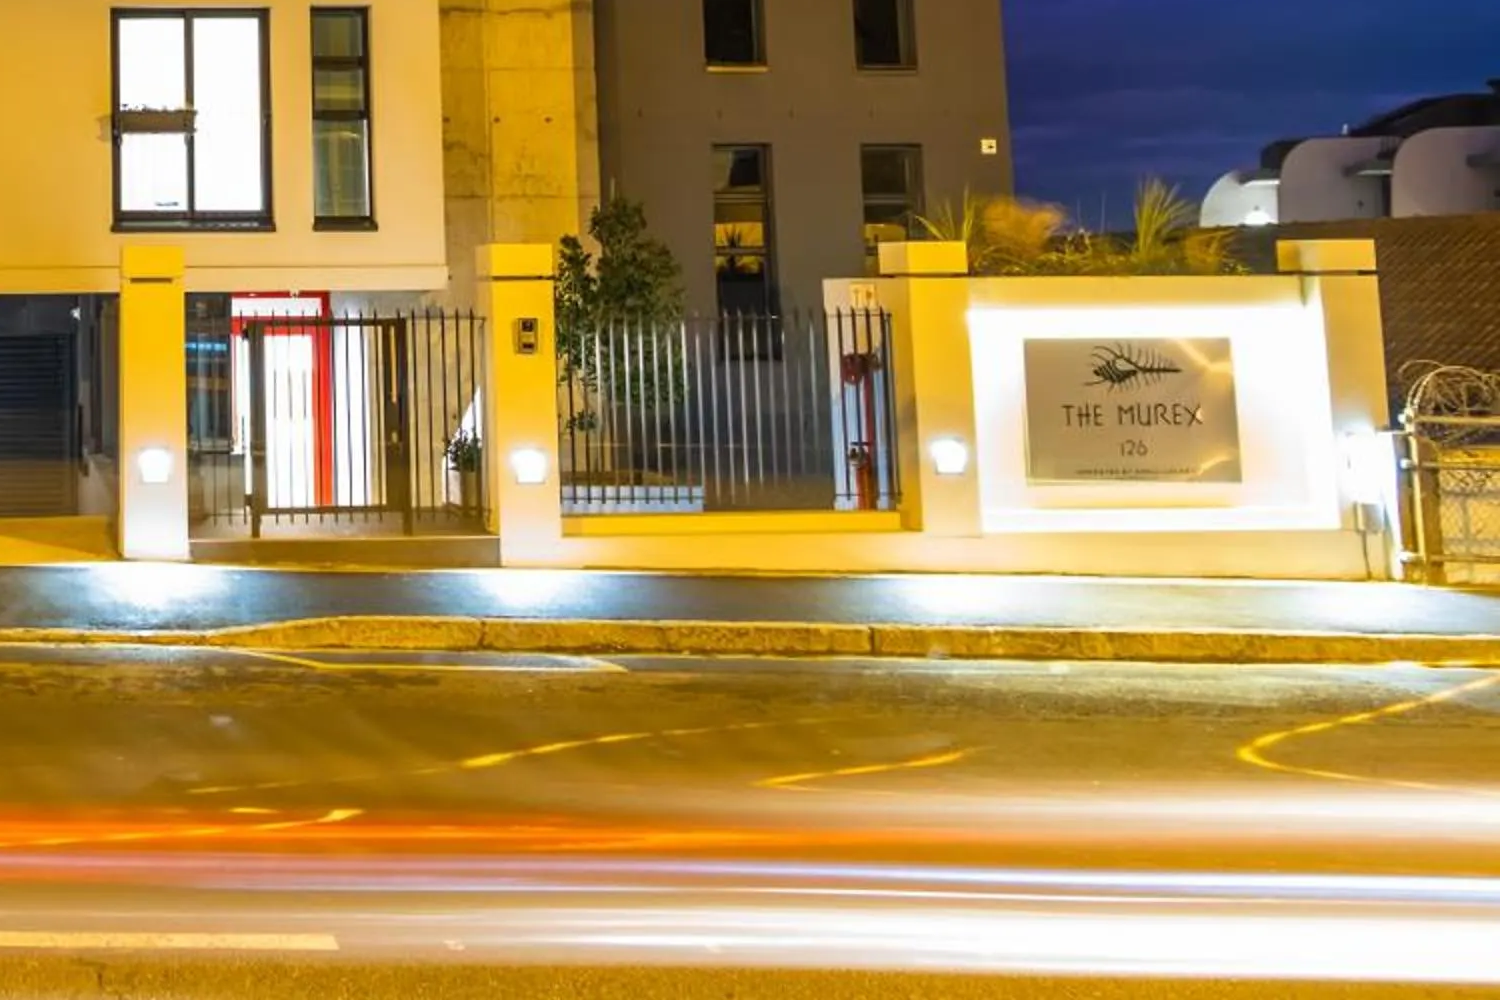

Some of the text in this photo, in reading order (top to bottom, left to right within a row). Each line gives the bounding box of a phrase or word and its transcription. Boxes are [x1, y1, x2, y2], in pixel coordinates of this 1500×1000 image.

[1061, 403, 1203, 428] THE MUREX
[1120, 440, 1148, 457] 126
